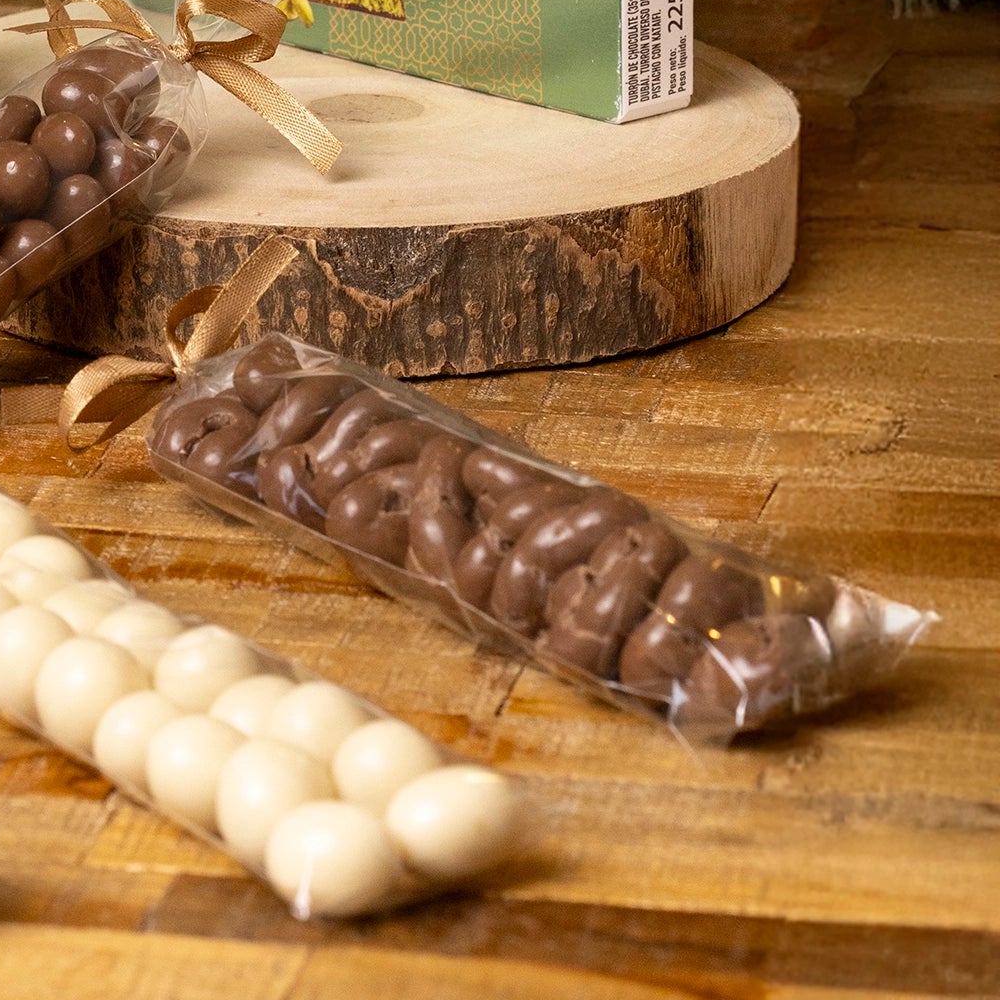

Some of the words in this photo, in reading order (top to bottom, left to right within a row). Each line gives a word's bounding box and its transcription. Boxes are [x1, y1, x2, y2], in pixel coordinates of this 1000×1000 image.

[628, 16, 638, 60] CHOCOLATE
[640, 8, 650, 41] DIVERSO
[652, 9, 662, 41] KATAIFI.
[628, 62, 638, 71] DE
[638, 43, 650, 74] TURRÓN
[652, 43, 662, 59] CON
[668, 48, 677, 71] neto:
[677, 35, 687, 68] líquido:
[626, 73, 638, 106] TURRÓN
[652, 61, 662, 99] PISTACHO
[668, 73, 677, 95] Peso
[677, 71, 687, 92] Peso
